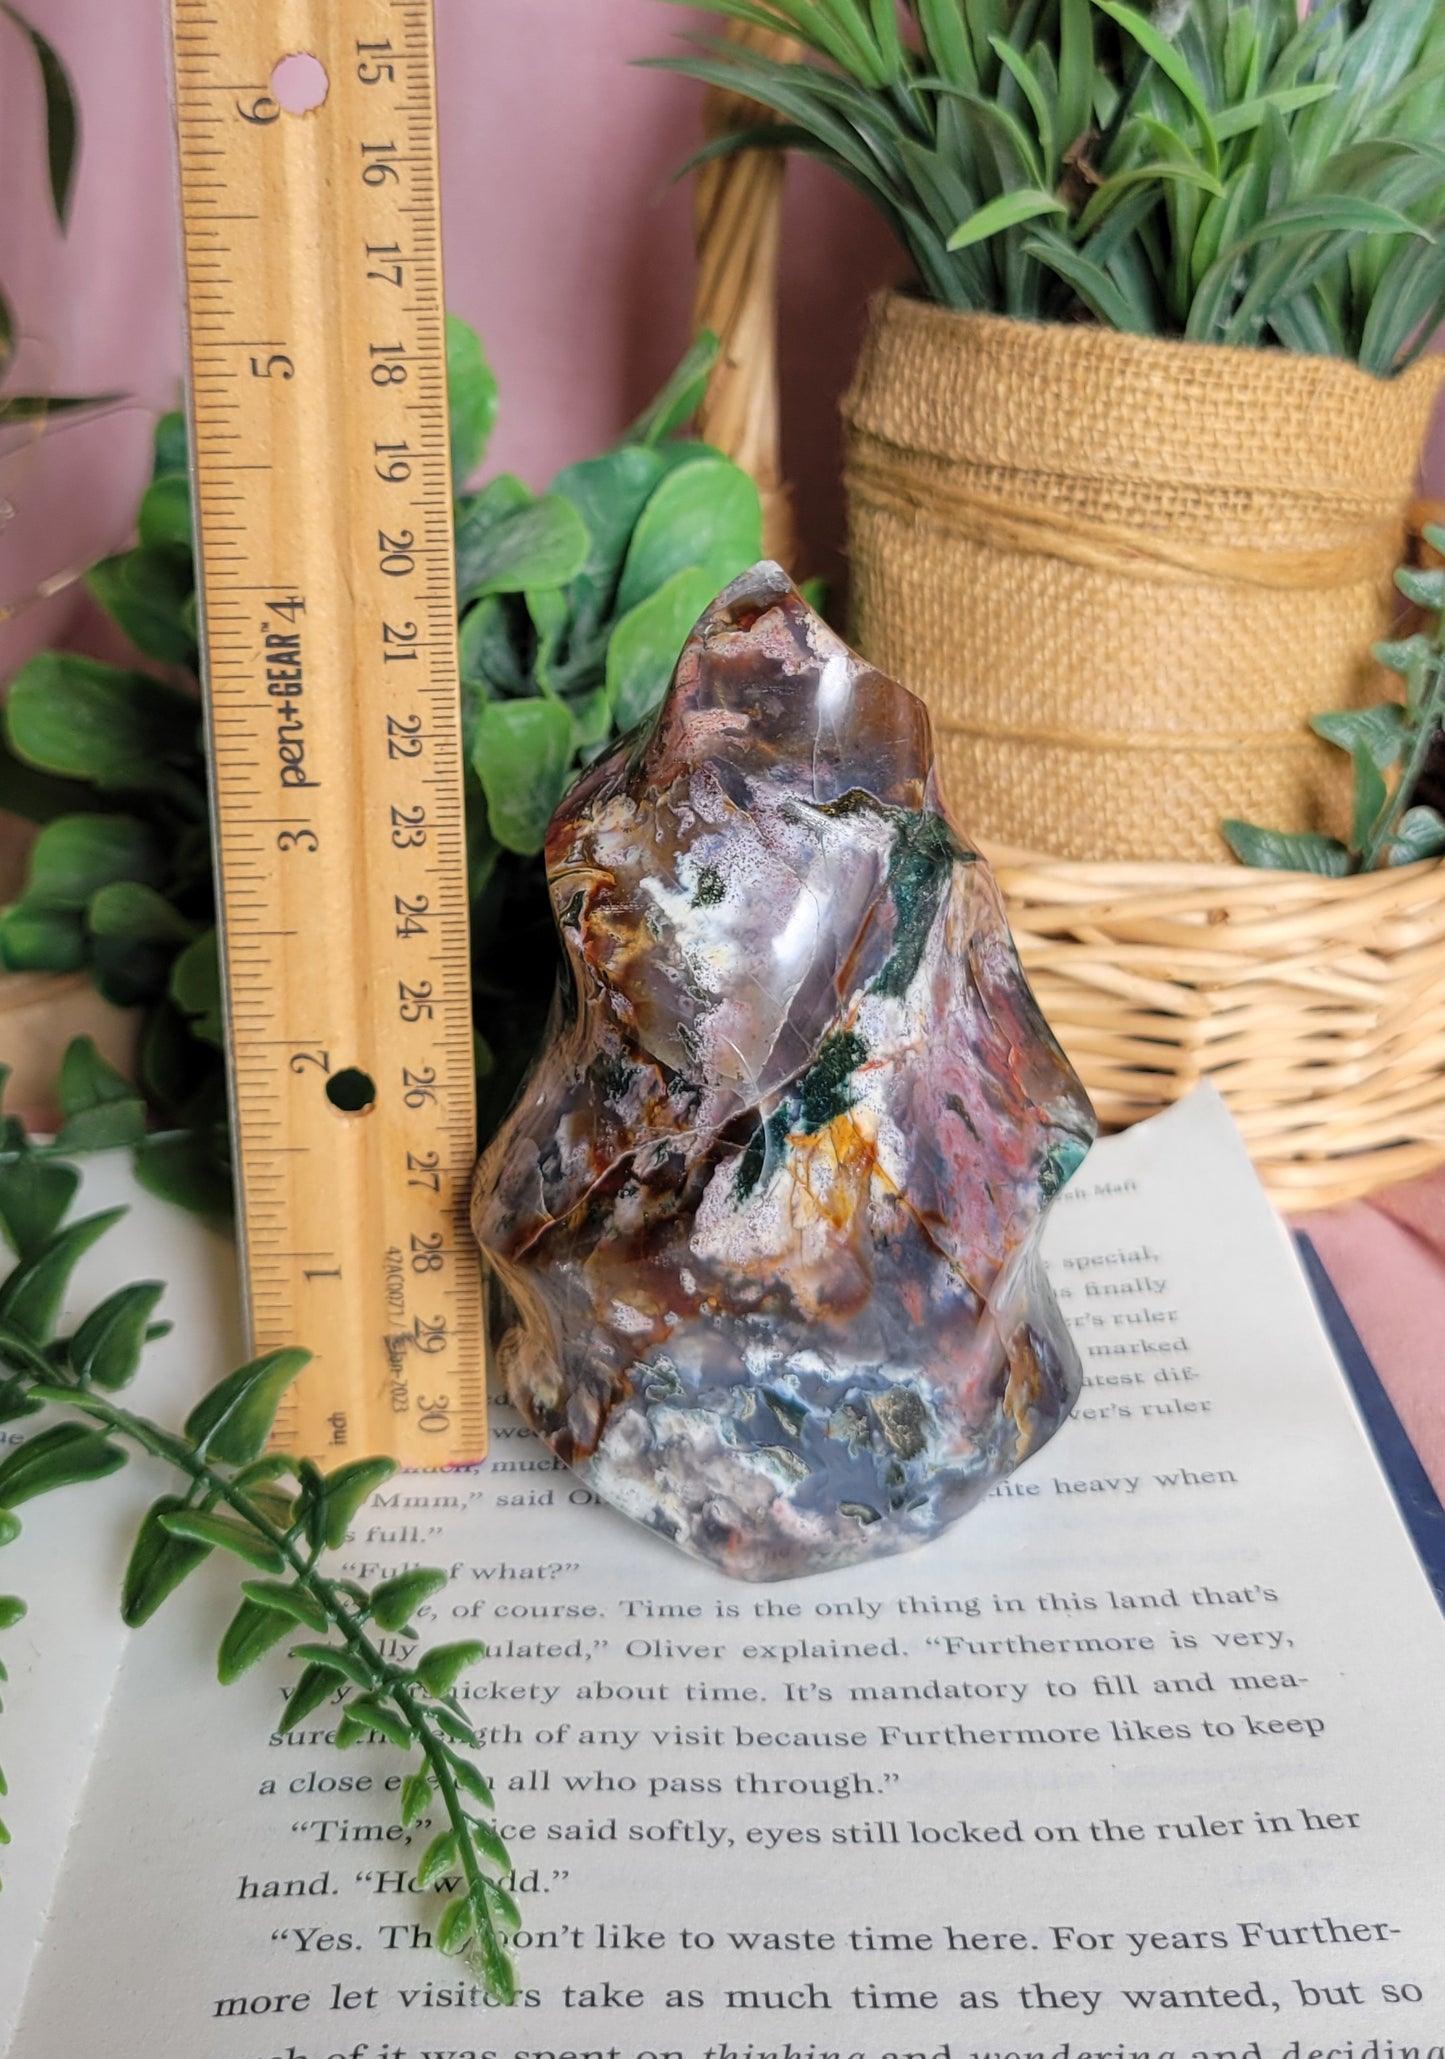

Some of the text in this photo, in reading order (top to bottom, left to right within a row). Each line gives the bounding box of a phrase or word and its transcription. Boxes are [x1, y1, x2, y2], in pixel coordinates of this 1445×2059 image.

[356, 39, 395, 85] 15
[236, 97, 280, 125] 6
[361, 141, 399, 186] 16
[366, 243, 403, 287] 17
[251, 354, 295, 380] 5
[370, 342, 408, 387] 18
[374, 440, 411, 483] 19
[378, 530, 414, 576] 20
[265, 596, 306, 623] 4
[382, 621, 417, 664] 21
[386, 714, 423, 760] 22
[277, 829, 319, 852] 3
[391, 805, 426, 849] 23
[395, 895, 429, 939] 24
[399, 980, 435, 1022] 25
[290, 1050, 331, 1074] 2
[403, 1066, 436, 1108] 26
[407, 1151, 440, 1193] 27
[411, 1233, 444, 1273] 28
[1062, 1245, 1160, 1270] special,
[305, 1265, 342, 1282] 1
[1084, 1276, 1168, 1297] finally
[1113, 1307, 1179, 1324] ruler
[414, 1315, 447, 1354] 29
[1088, 1337, 1189, 1356] marked
[1154, 1367, 1200, 1384] dif-
[418, 1394, 449, 1433] 30
[1068, 1397, 1213, 1421] ver’s ruler
[495, 1489, 555, 1507] said
[1052, 1476, 1139, 1496] heavy
[1153, 1468, 1238, 1488] when
[451, 1600, 486, 1618] of
[493, 1605, 605, 1619] course.
[618, 1599, 702, 1618] Time
[715, 1599, 740, 1618] is
[754, 1599, 801, 1618] the
[814, 1596, 882, 1620] only
[897, 1595, 982, 1618] thing
[993, 1594, 1026, 1613] in
[1037, 1592, 1098, 1612] this
[1107, 1588, 1181, 1610] land
[1191, 1584, 1279, 1606] that’s
[485, 1630, 1294, 1664] ulated,” Oliver explained. “Furthermore is very,
[576, 1680, 668, 1701] about
[686, 1682, 766, 1702] time.
[785, 1682, 833, 1702] It’s
[850, 1679, 1027, 1703] mandatory
[1046, 1680, 1077, 1698] to
[1093, 1674, 1139, 1696] fill
[1153, 1671, 1216, 1694] and
[1229, 1674, 1308, 1691] mea-
[535, 1724, 571, 1744] of
[578, 1730, 639, 1751] any
[652, 1725, 723, 1747] visit
[735, 1725, 867, 1747] because
[878, 1724, 1100, 1746] Furthermore
[1110, 1719, 1192, 1742] likes
[1202, 1720, 1235, 1738] to
[1243, 1714, 1325, 1738] keep
[258, 1780, 276, 1796] a
[289, 1771, 374, 1794] close
[508, 1769, 550, 1791] all
[563, 1770, 637, 1792] who
[648, 1777, 722, 1798] pass
[736, 1772, 899, 1800] through.”
[290, 1818, 433, 1846] “Time,”
[547, 1818, 617, 1841] said
[628, 1819, 735, 1849] softly,
[746, 1827, 822, 1850] eyes
[832, 1821, 900, 1844] still
[909, 1819, 1025, 1844] locked
[1034, 1826, 1080, 1842] on
[1089, 1819, 1145, 1842] the
[1156, 1814, 1244, 1840] ruler
[1254, 1811, 1295, 1834] in
[1297, 1808, 1360, 1831] her
[237, 1871, 338, 1900] hand.
[271, 1927, 362, 1953] “Yes.
[595, 1923, 666, 1950] like
[679, 1928, 715, 1950] to
[727, 1929, 836, 1951] waste
[848, 1926, 933, 1952] time
[943, 1925, 1038, 1951] here.
[1049, 1926, 1115, 1951] For
[1126, 1931, 1229, 1957] years
[1236, 1916, 1401, 1948] Further-
[213, 1993, 311, 2018] more
[329, 1983, 379, 2010] let
[562, 1981, 644, 2009] take
[665, 1989, 705, 2009] as
[724, 1982, 833, 2010] much
[851, 1983, 939, 2010] time
[959, 1990, 999, 2010] as
[1018, 1982, 1102, 2016] they
[1121, 1980, 1280, 2013] wanted,
[1292, 1979, 1365, 2007] but
[1381, 1983, 1423, 2003] so
